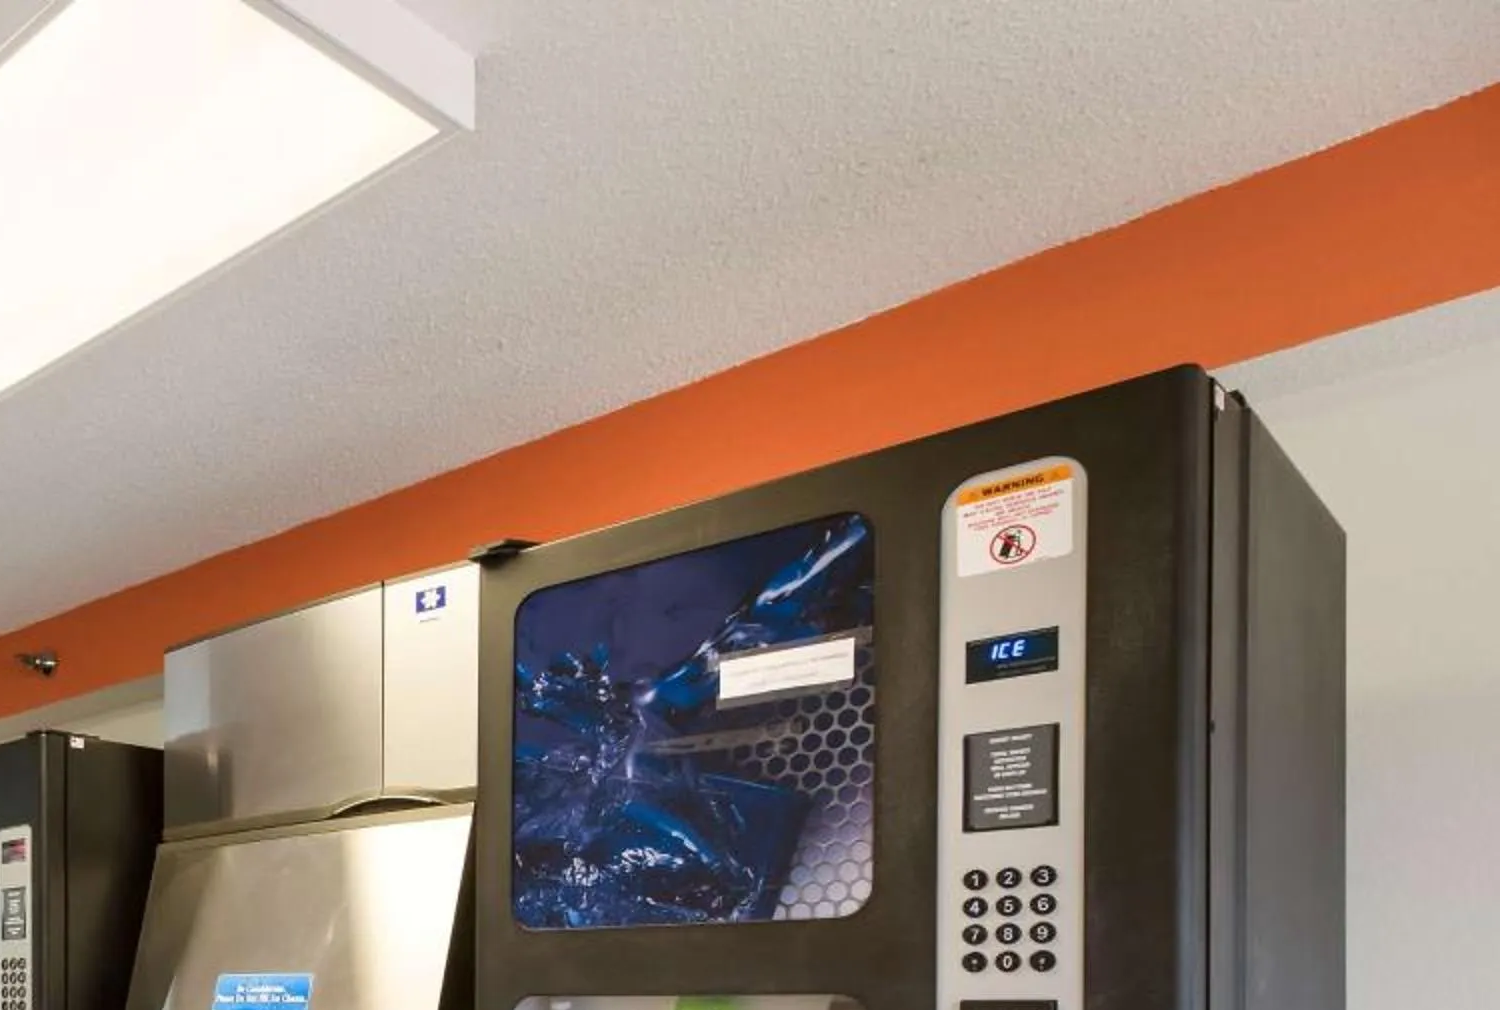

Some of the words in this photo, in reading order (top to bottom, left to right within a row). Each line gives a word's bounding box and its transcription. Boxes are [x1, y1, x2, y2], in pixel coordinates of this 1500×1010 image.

[981, 473, 1045, 497] WARNING
[991, 639, 1026, 661] ICE
[972, 874, 979, 887] 1
[1004, 871, 1013, 885] 2
[1037, 869, 1049, 883] 3
[970, 900, 980, 915] 4
[1003, 899, 1014, 913] 5
[1037, 898, 1049, 912] 6
[971, 927, 979, 942] 7
[1003, 927, 1013, 941] 8
[1037, 925, 1048, 940] 9
[1003, 955, 1013, 969] 0
